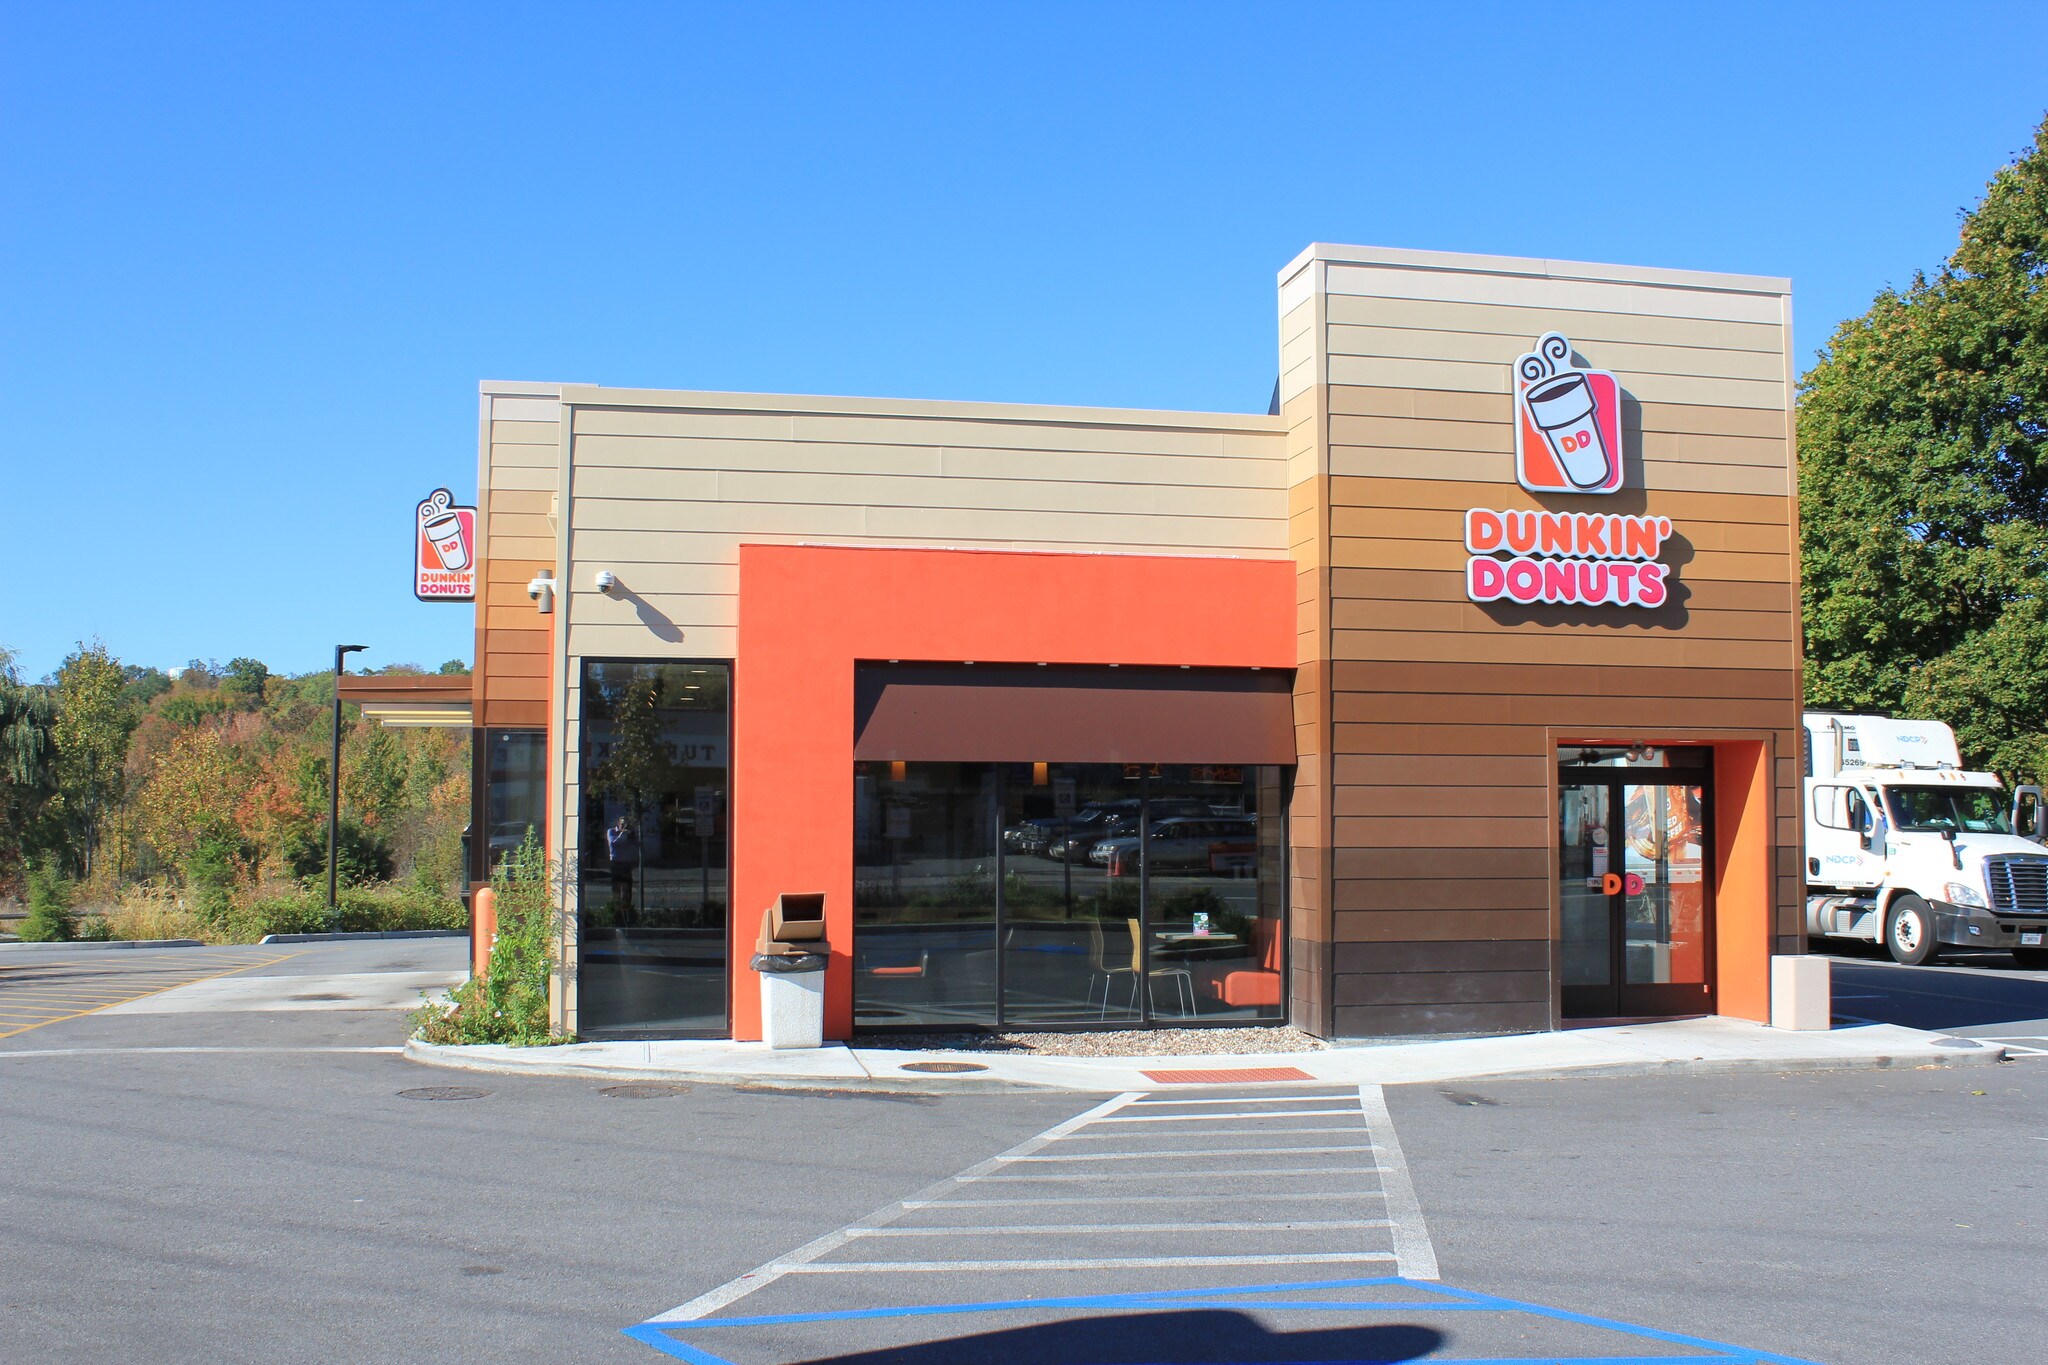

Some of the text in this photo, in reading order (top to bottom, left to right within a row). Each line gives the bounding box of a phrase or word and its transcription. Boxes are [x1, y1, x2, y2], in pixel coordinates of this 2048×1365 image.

[1560, 430, 1591, 453] DD
[1470, 511, 1669, 558] DUNKIN'
[441, 541, 458, 553] DD
[421, 573, 474, 583] DUNKIN'
[1472, 559, 1665, 604] DONUTS
[420, 584, 471, 594] DONUTS
[1896, 735, 1920, 744] NDCP
[1825, 855, 1856, 864] NDCP
